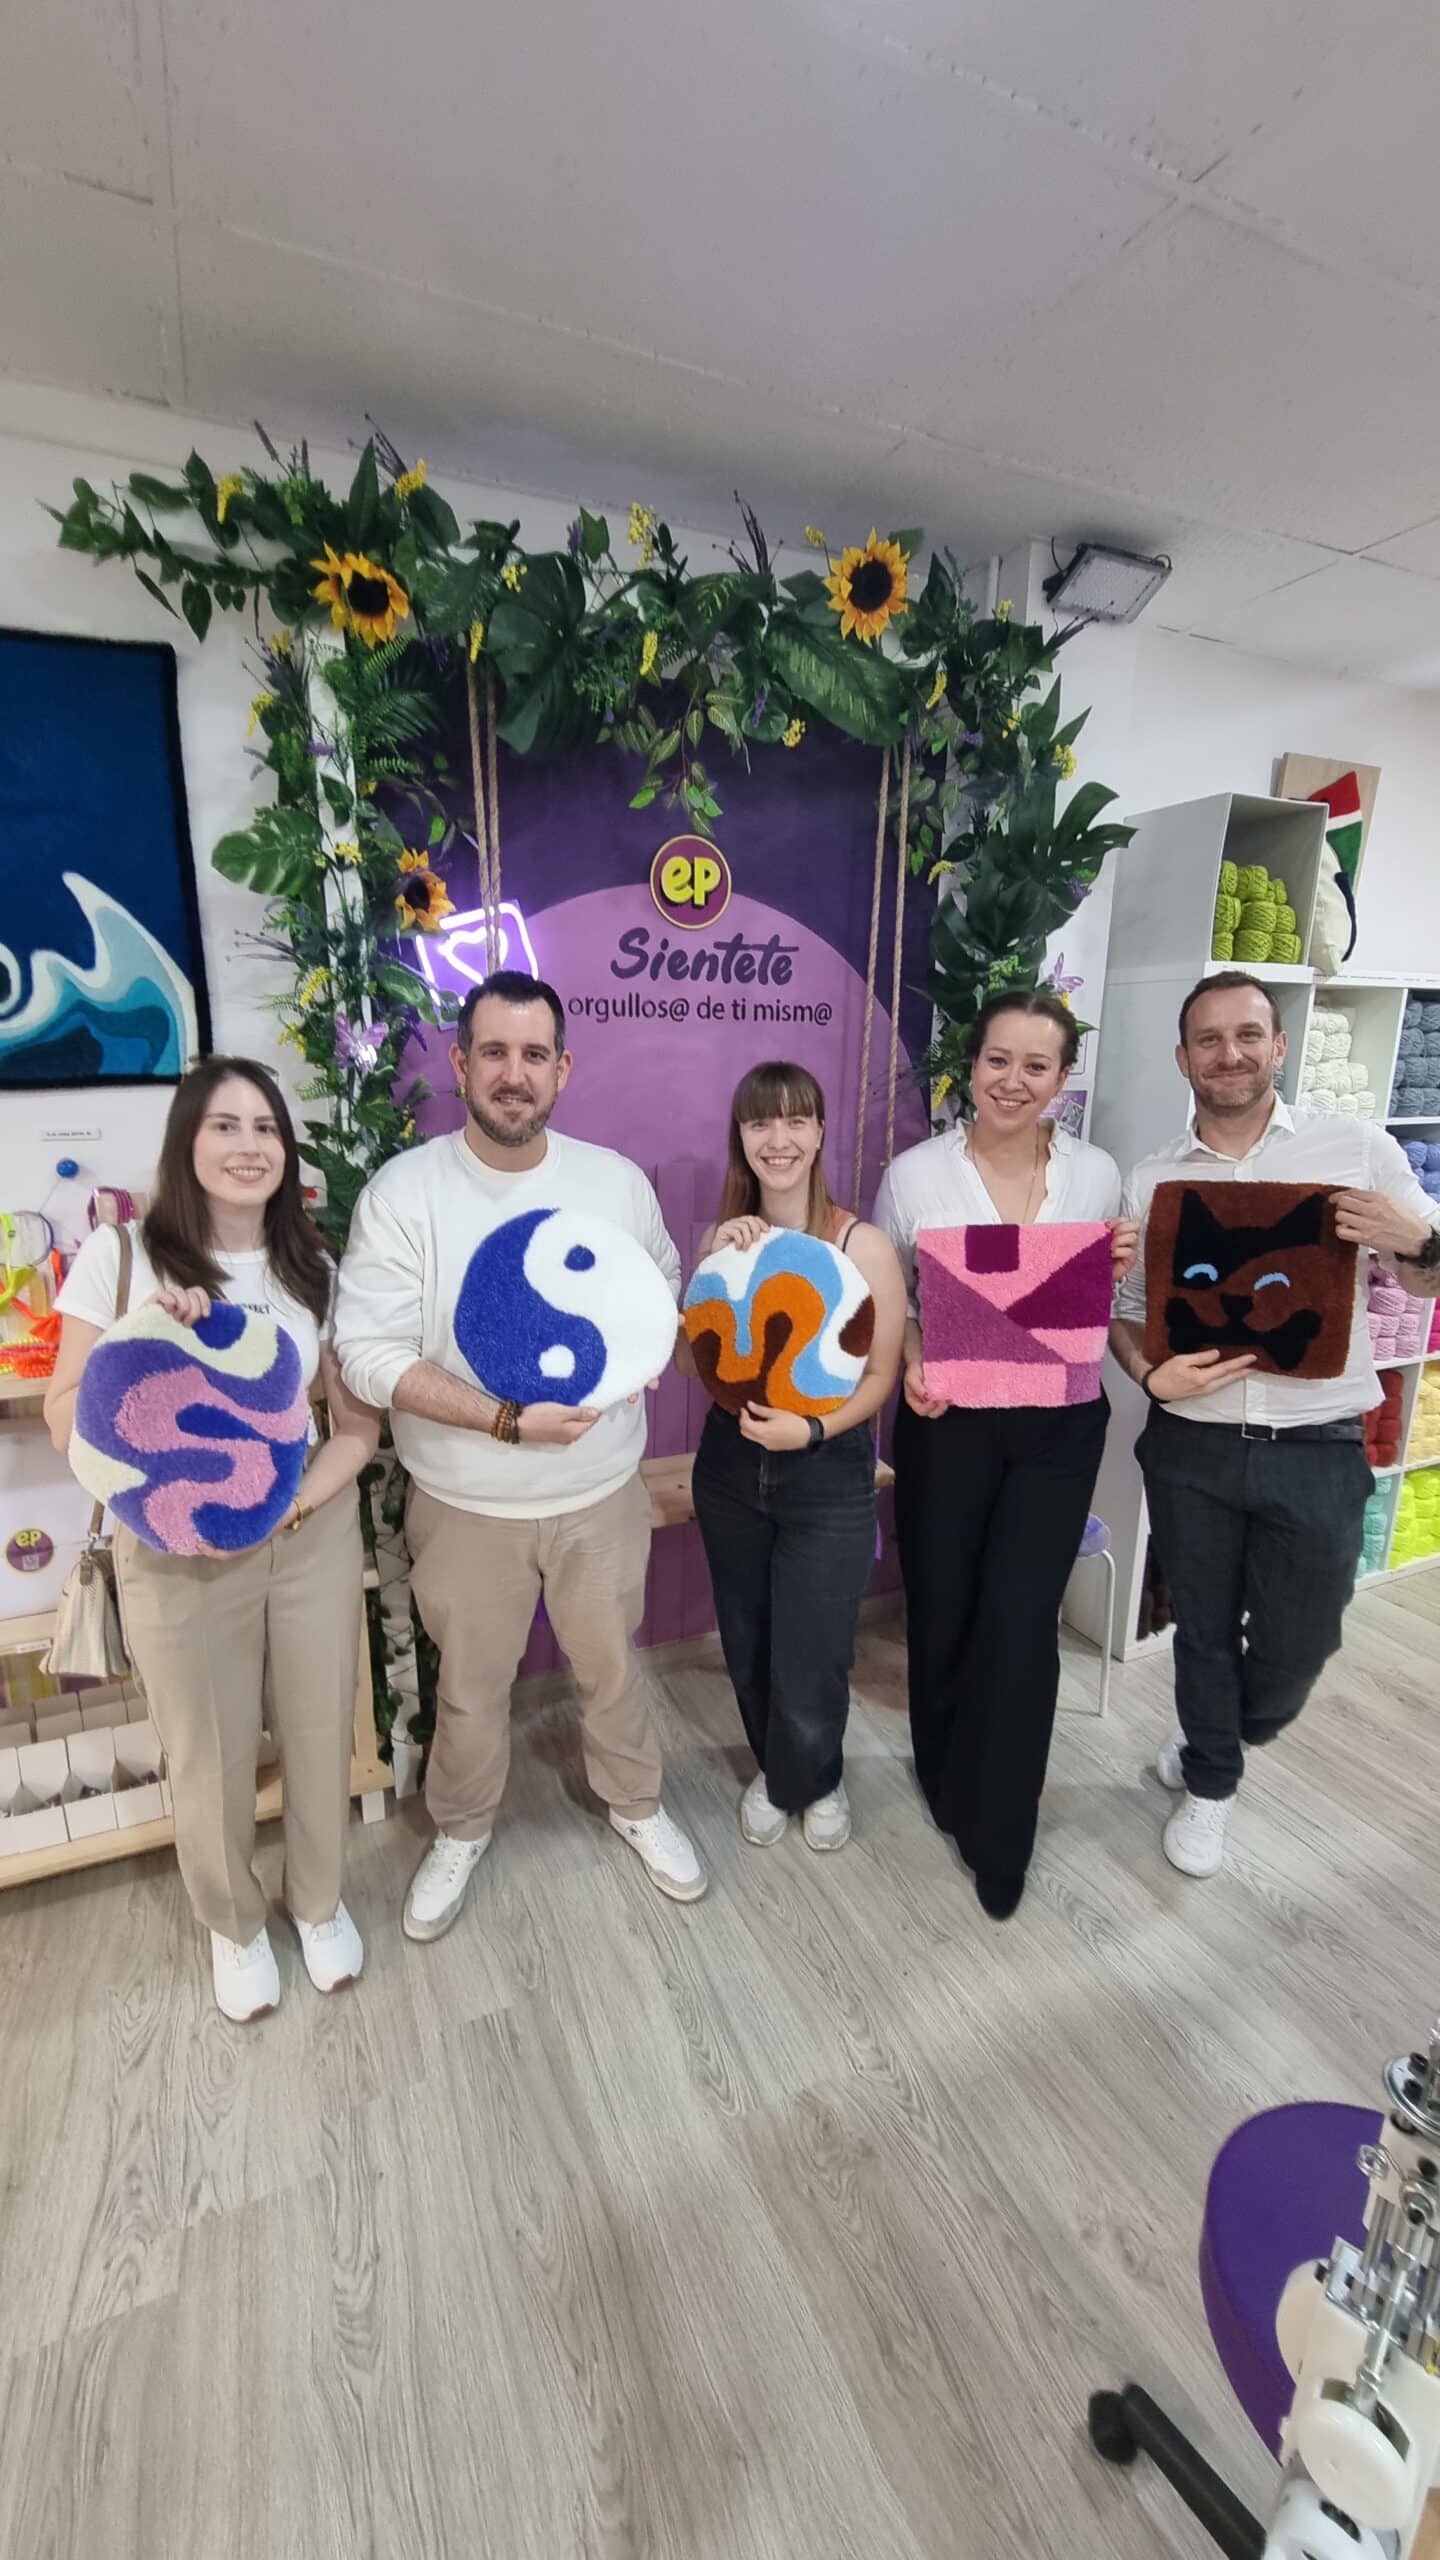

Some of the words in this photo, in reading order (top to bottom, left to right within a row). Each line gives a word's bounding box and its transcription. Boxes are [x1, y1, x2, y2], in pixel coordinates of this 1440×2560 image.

[660, 855, 721, 906] ep
[610, 927, 799, 985] Sientete
[568, 993, 690, 1023] orgullos@
[697, 997, 725, 1020] de
[731, 998, 747, 1021] ti
[754, 1000, 833, 1025] mism@
